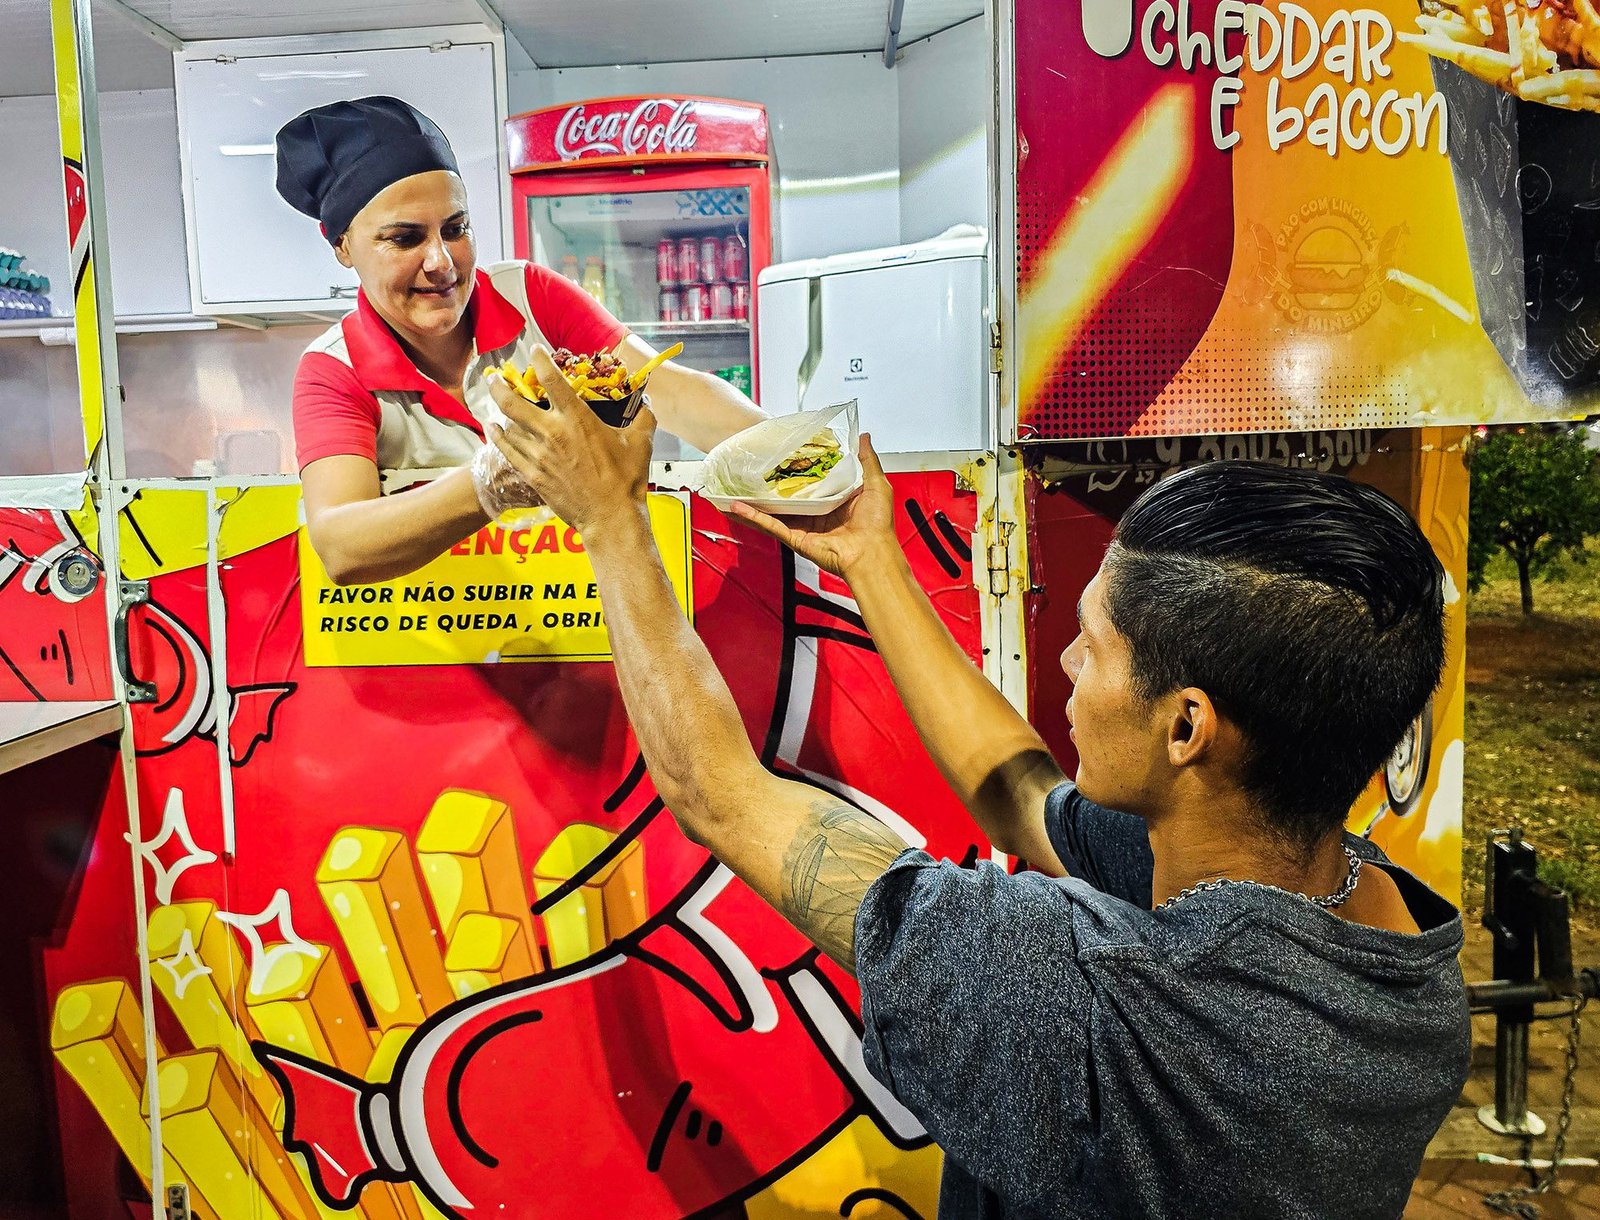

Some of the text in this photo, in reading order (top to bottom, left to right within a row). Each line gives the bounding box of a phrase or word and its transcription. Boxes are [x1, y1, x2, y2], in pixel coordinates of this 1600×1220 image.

[554, 99, 699, 159] Coca-Cola
[1211, 76, 1244, 150] E
[1300, 196, 1329, 217] COM
[1276, 290, 1383, 332] DO MINEIRO
[449, 525, 587, 564] ENÇAO
[318, 581, 601, 604] FAVOR NÃO SUBIR NA E
[320, 615, 389, 632] RISCO
[399, 615, 428, 631] DE
[437, 613, 518, 633] QUEDA
[542, 611, 608, 628] OBRI
